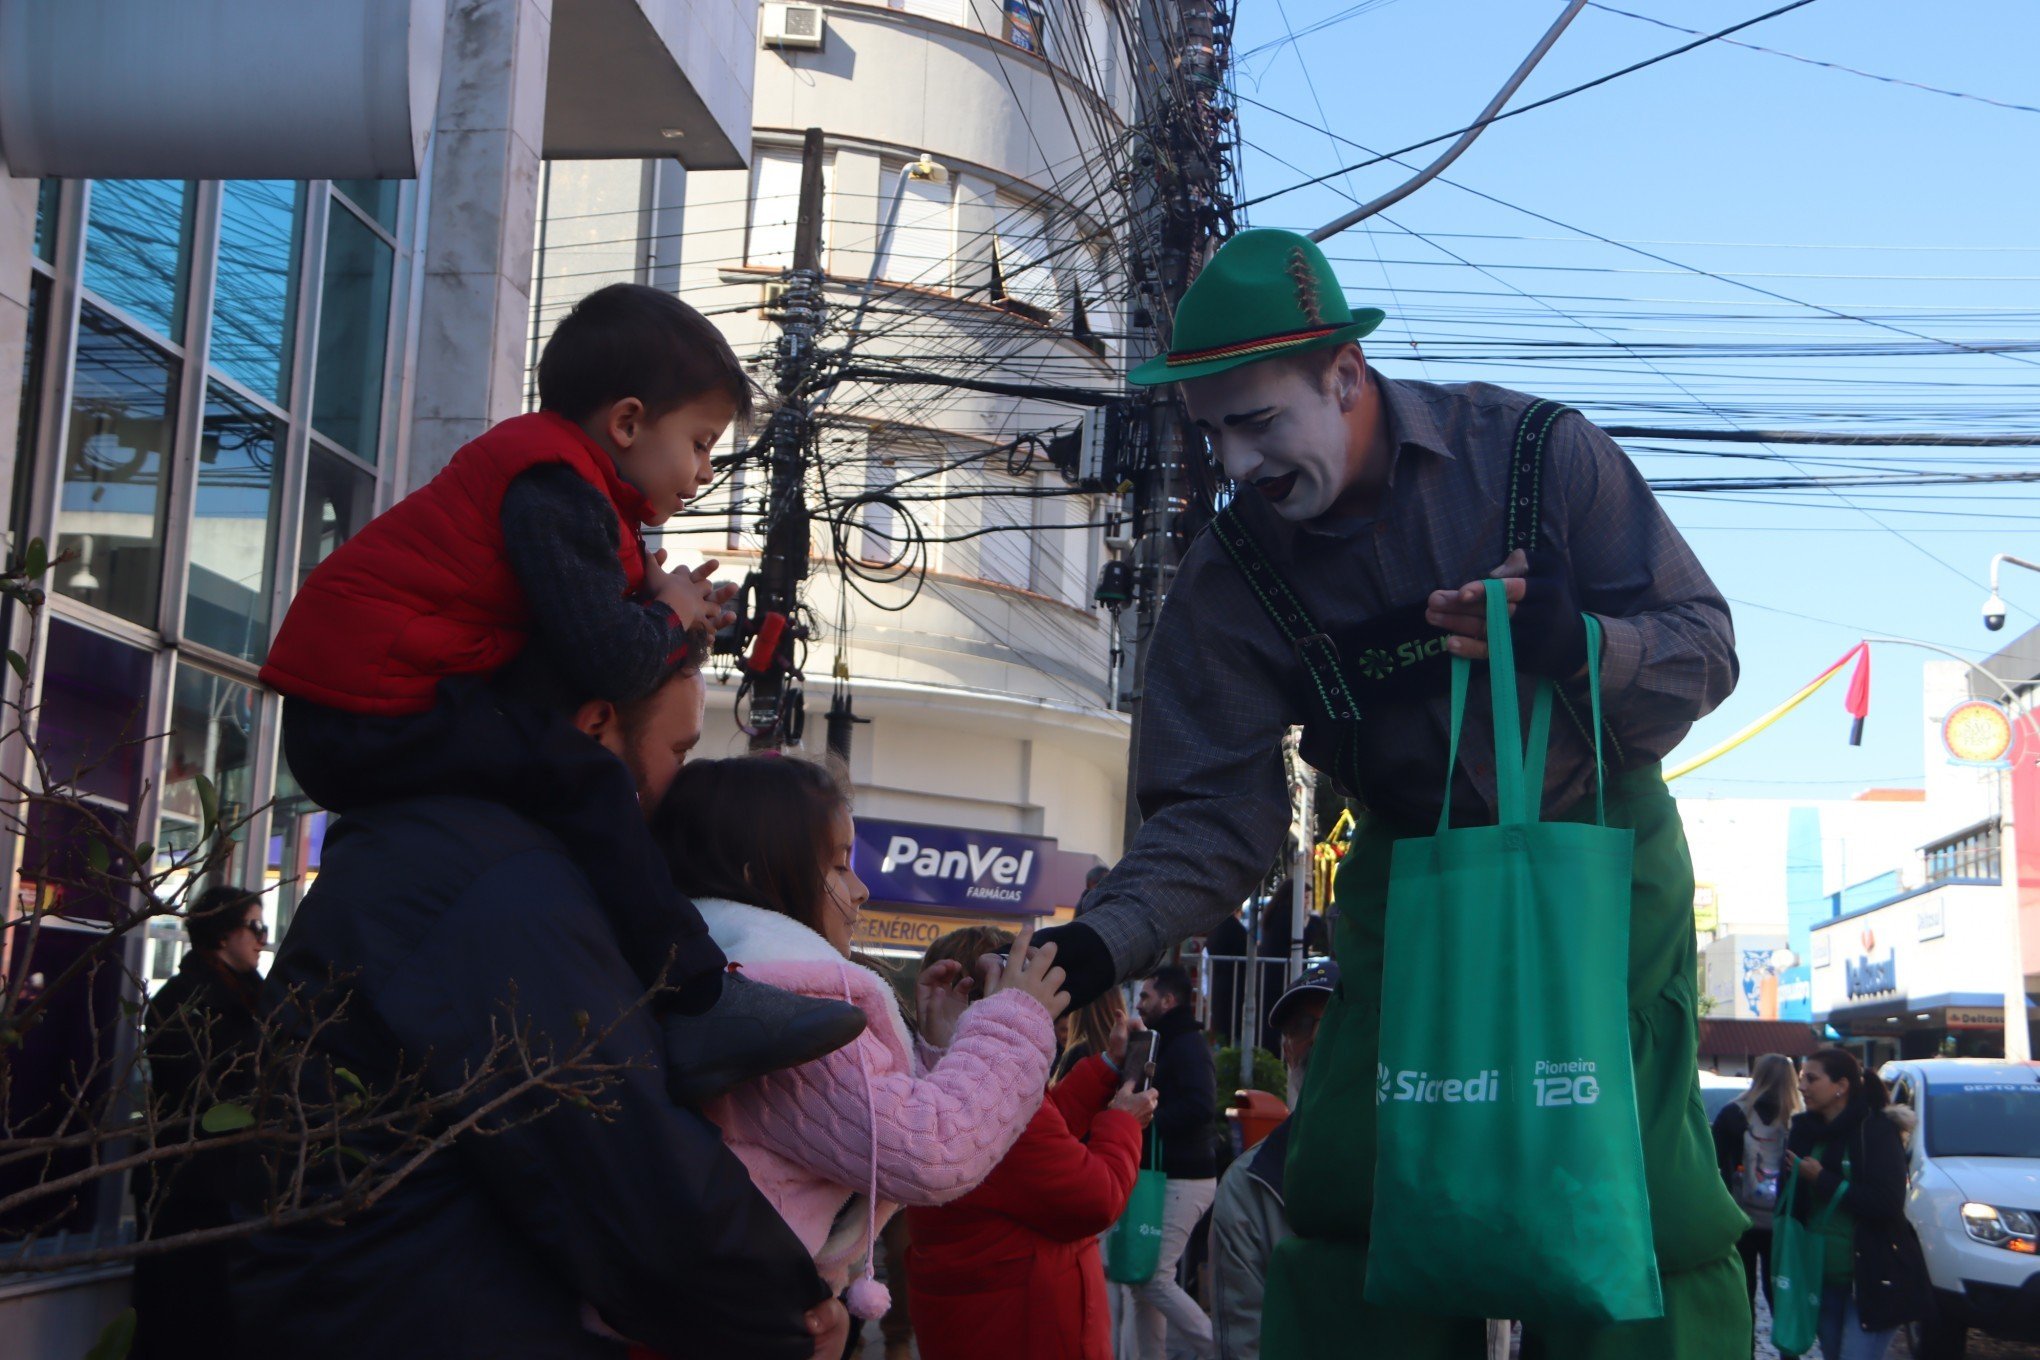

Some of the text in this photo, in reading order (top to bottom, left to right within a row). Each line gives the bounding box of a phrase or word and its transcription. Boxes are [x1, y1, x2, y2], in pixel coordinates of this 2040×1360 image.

[1396, 634, 1450, 667] Sicr
[881, 836, 1034, 886] PanVel
[966, 886, 1022, 902] FARMÁCIAS
[1535, 1058, 1596, 1076] Pioneira
[1394, 1070, 1499, 1104] Sicredi
[1533, 1075, 1599, 1107] 120
